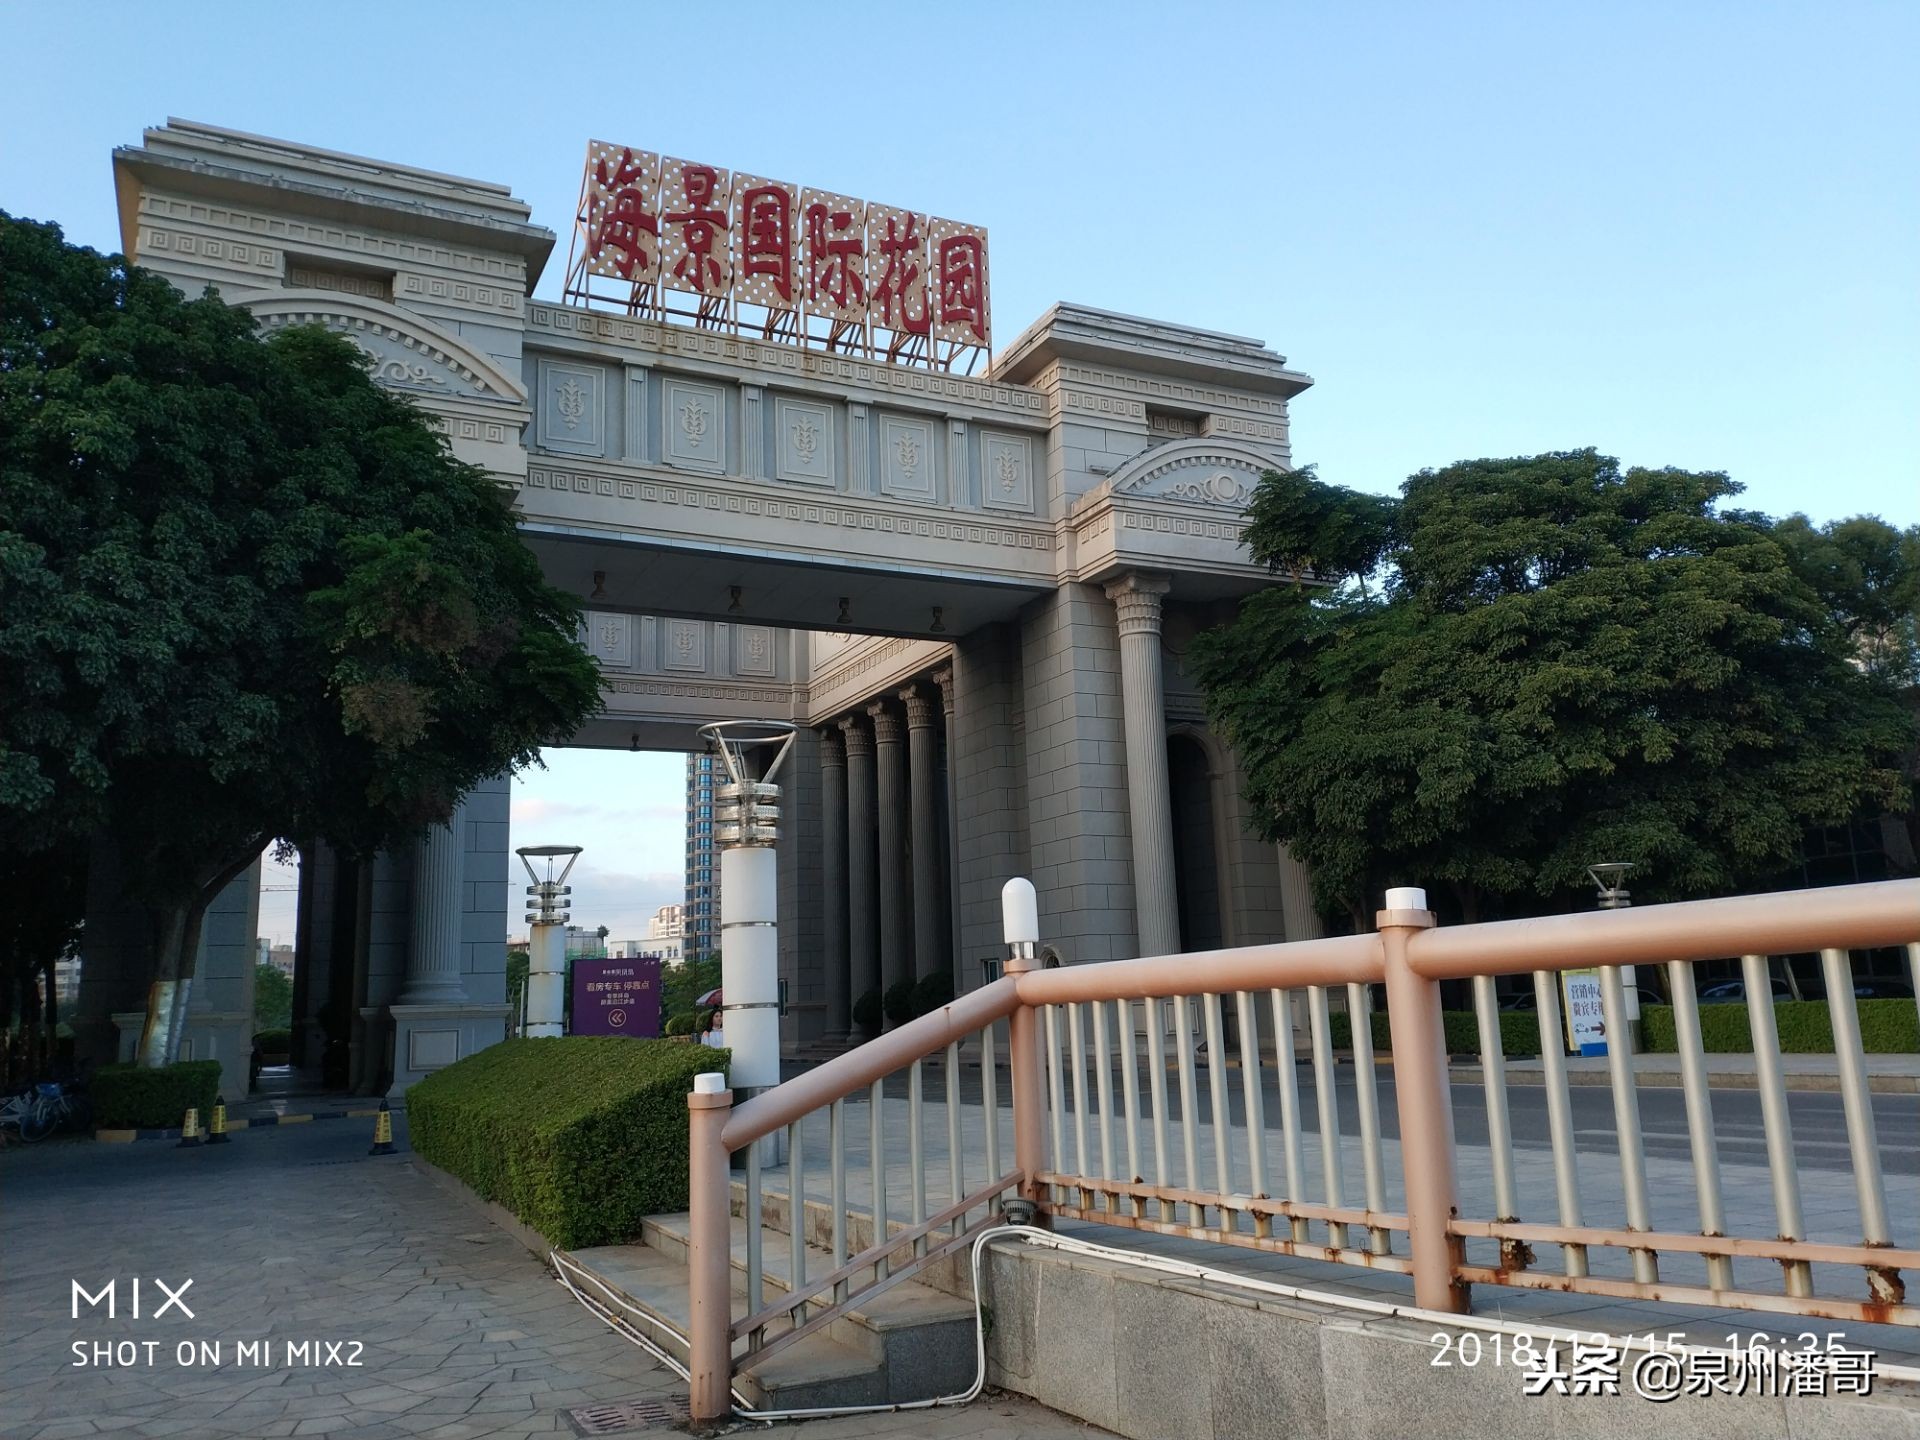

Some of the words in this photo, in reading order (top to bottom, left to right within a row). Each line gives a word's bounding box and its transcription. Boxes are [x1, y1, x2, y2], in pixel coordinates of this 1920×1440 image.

[587, 146, 986, 341] 海景国际花园
